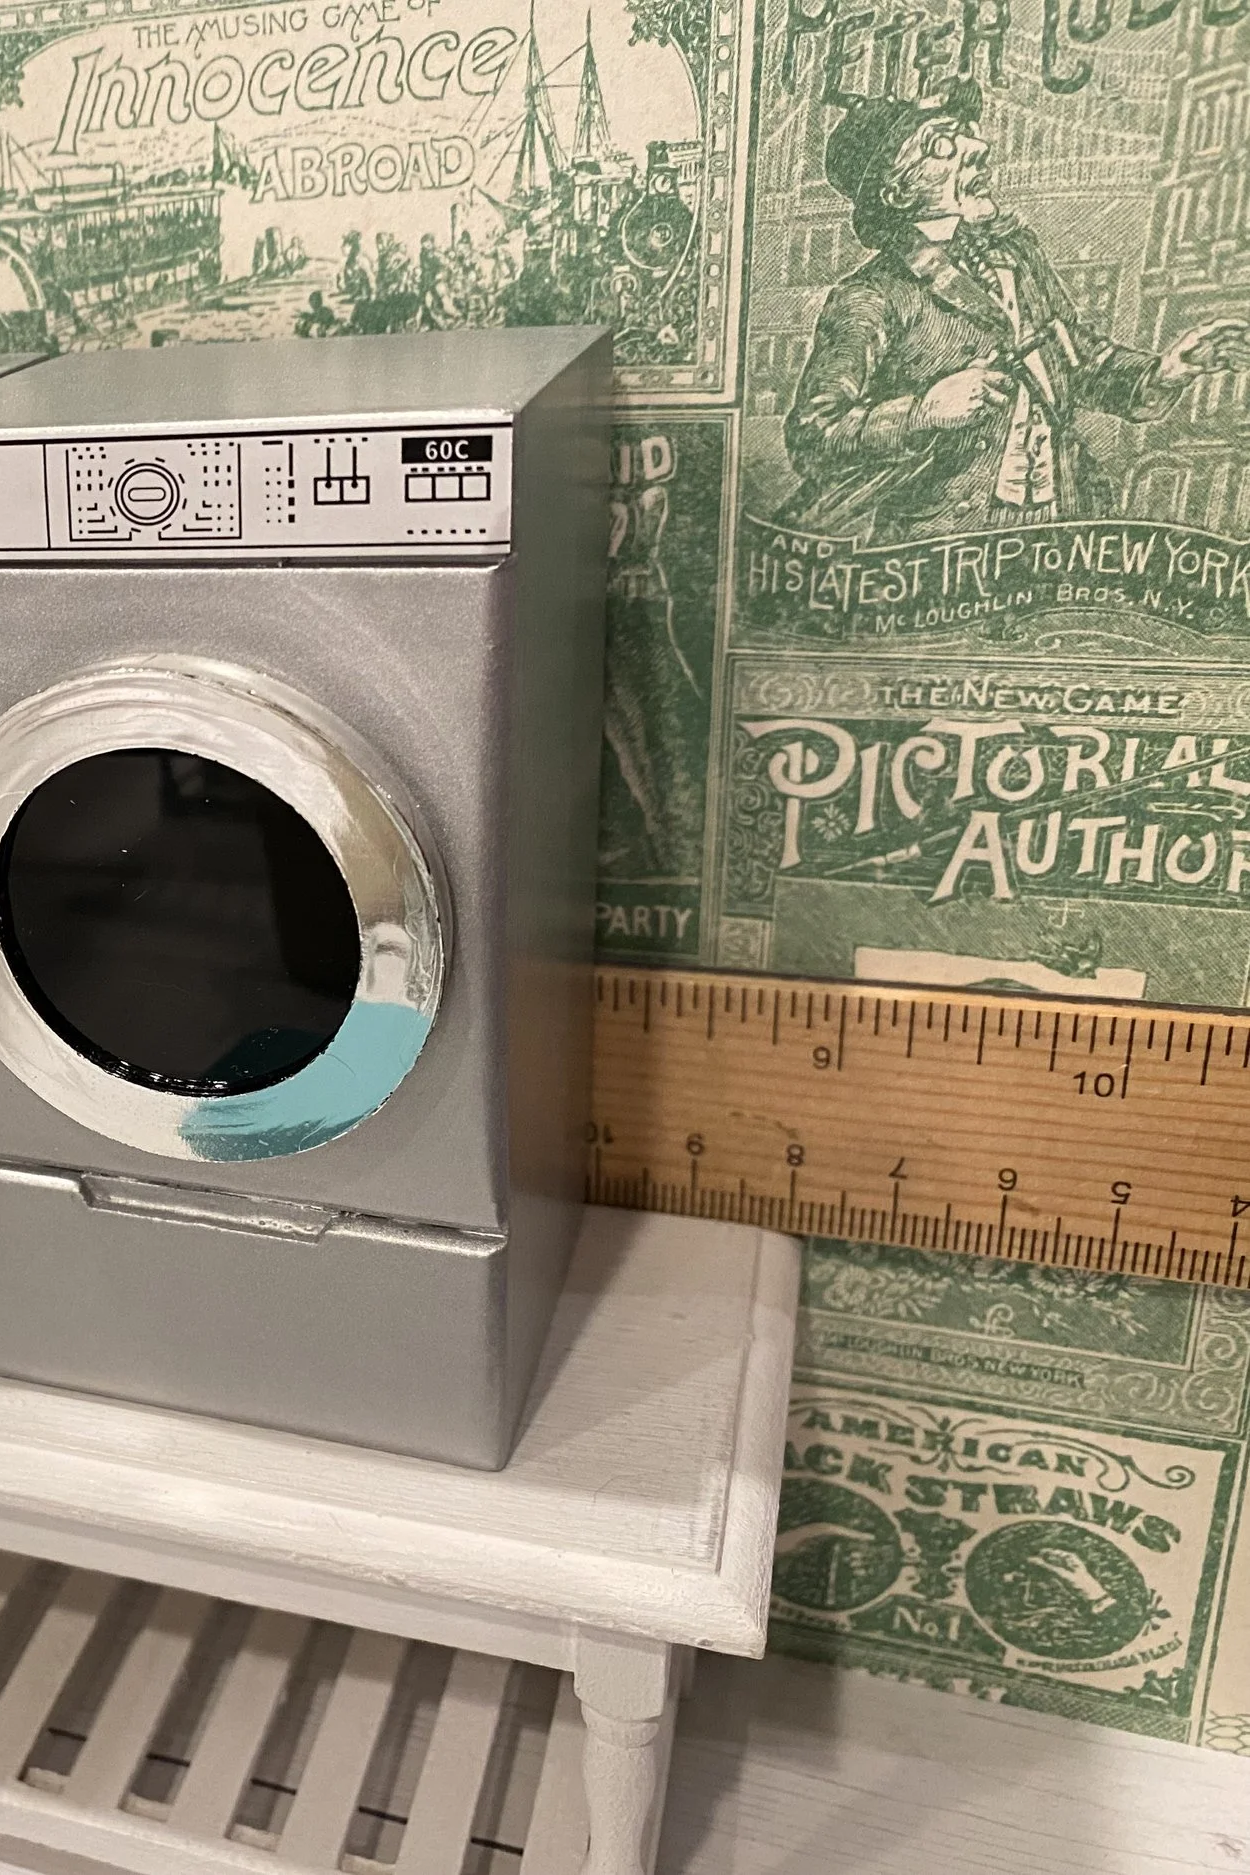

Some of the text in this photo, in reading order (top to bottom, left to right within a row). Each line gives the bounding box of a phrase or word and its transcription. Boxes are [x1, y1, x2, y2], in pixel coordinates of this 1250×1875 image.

[133, 22, 180, 50] THE
[185, 9, 309, 59] AMUSING
[322, 0, 401, 42] GAME
[52, 26, 518, 156] Innocence
[249, 136, 478, 202] ABROAD
[424, 440, 469, 461] 60C
[751, 551, 804, 594] HIS
[808, 556, 930, 613] LATEST
[930, 537, 1025, 598] TRIP
[1067, 531, 1158, 576] NEW
[772, 534, 834, 560] AND
[878, 677, 1180, 716] THE NEW GAME
[737, 717, 1250, 871] PICTORIAL
[812, 1046, 831, 1070] 9
[1072, 1070, 1115, 1098] 10
[786, 1143, 805, 1167] 8
[888, 1156, 908, 1180] 7
[1110, 1181, 1132, 1205] 5
[802, 1407, 1088, 1478] AMERICAN
[905, 1473, 1181, 1554] STRAWS
